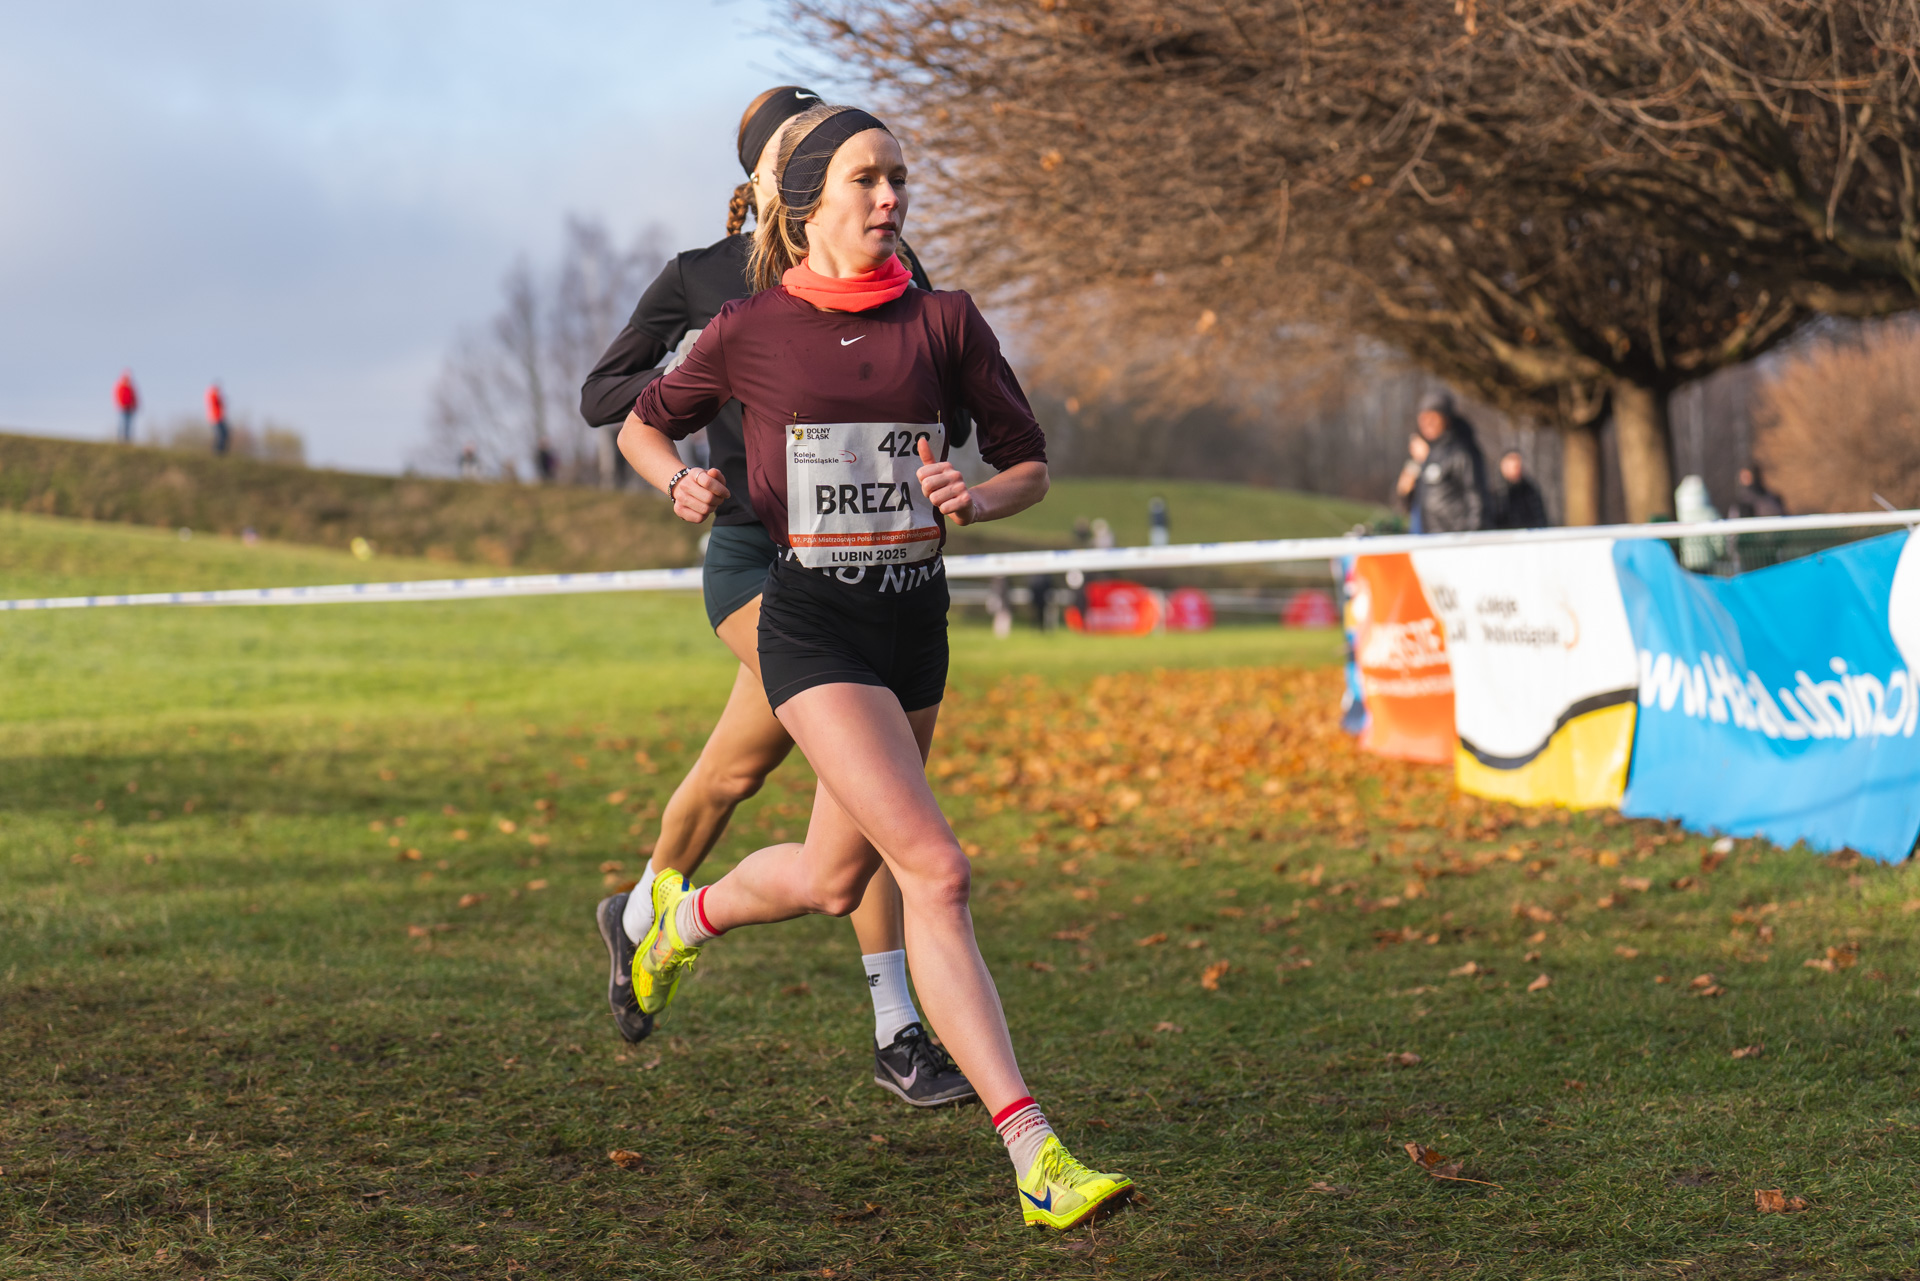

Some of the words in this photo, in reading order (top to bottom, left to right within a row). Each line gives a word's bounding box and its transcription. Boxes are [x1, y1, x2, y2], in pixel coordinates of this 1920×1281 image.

[794, 451, 816, 459] Koleje
[816, 482, 914, 514] BREZA
[832, 551, 873, 562] LUBIN
[876, 548, 907, 560] 2025
